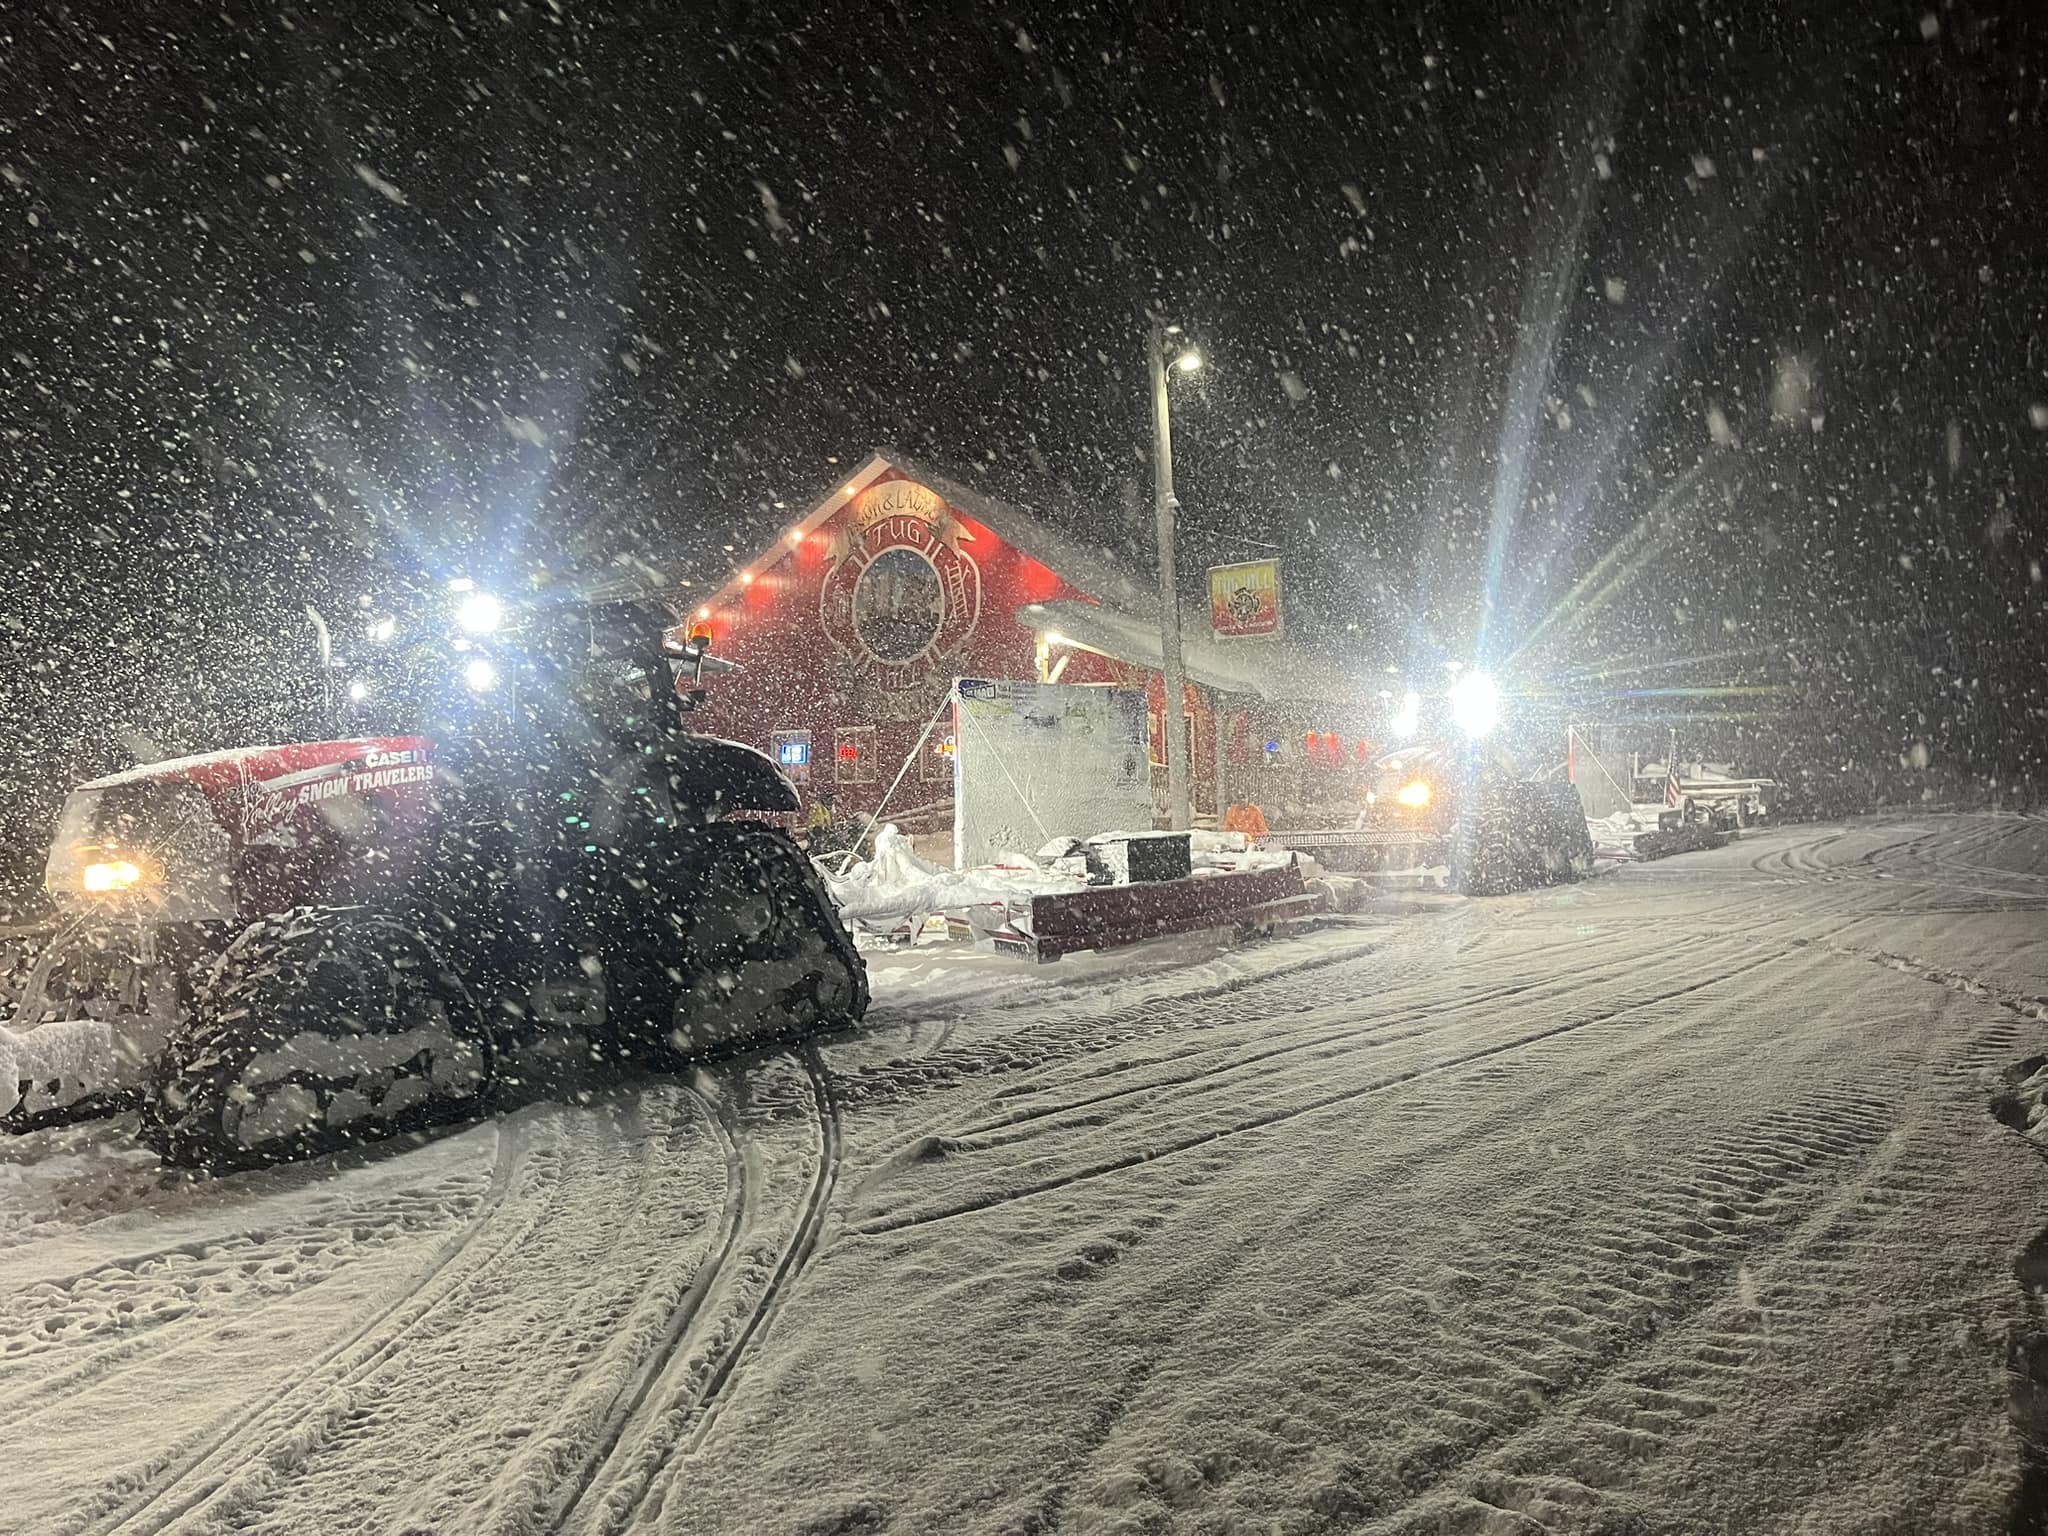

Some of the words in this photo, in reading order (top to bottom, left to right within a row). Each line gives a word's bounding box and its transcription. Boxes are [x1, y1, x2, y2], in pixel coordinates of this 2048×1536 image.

[872, 518, 920, 546] TUG
[366, 751, 412, 768] CASE
[299, 777, 349, 803] SNOW
[352, 764, 433, 791] TRAVELERS
